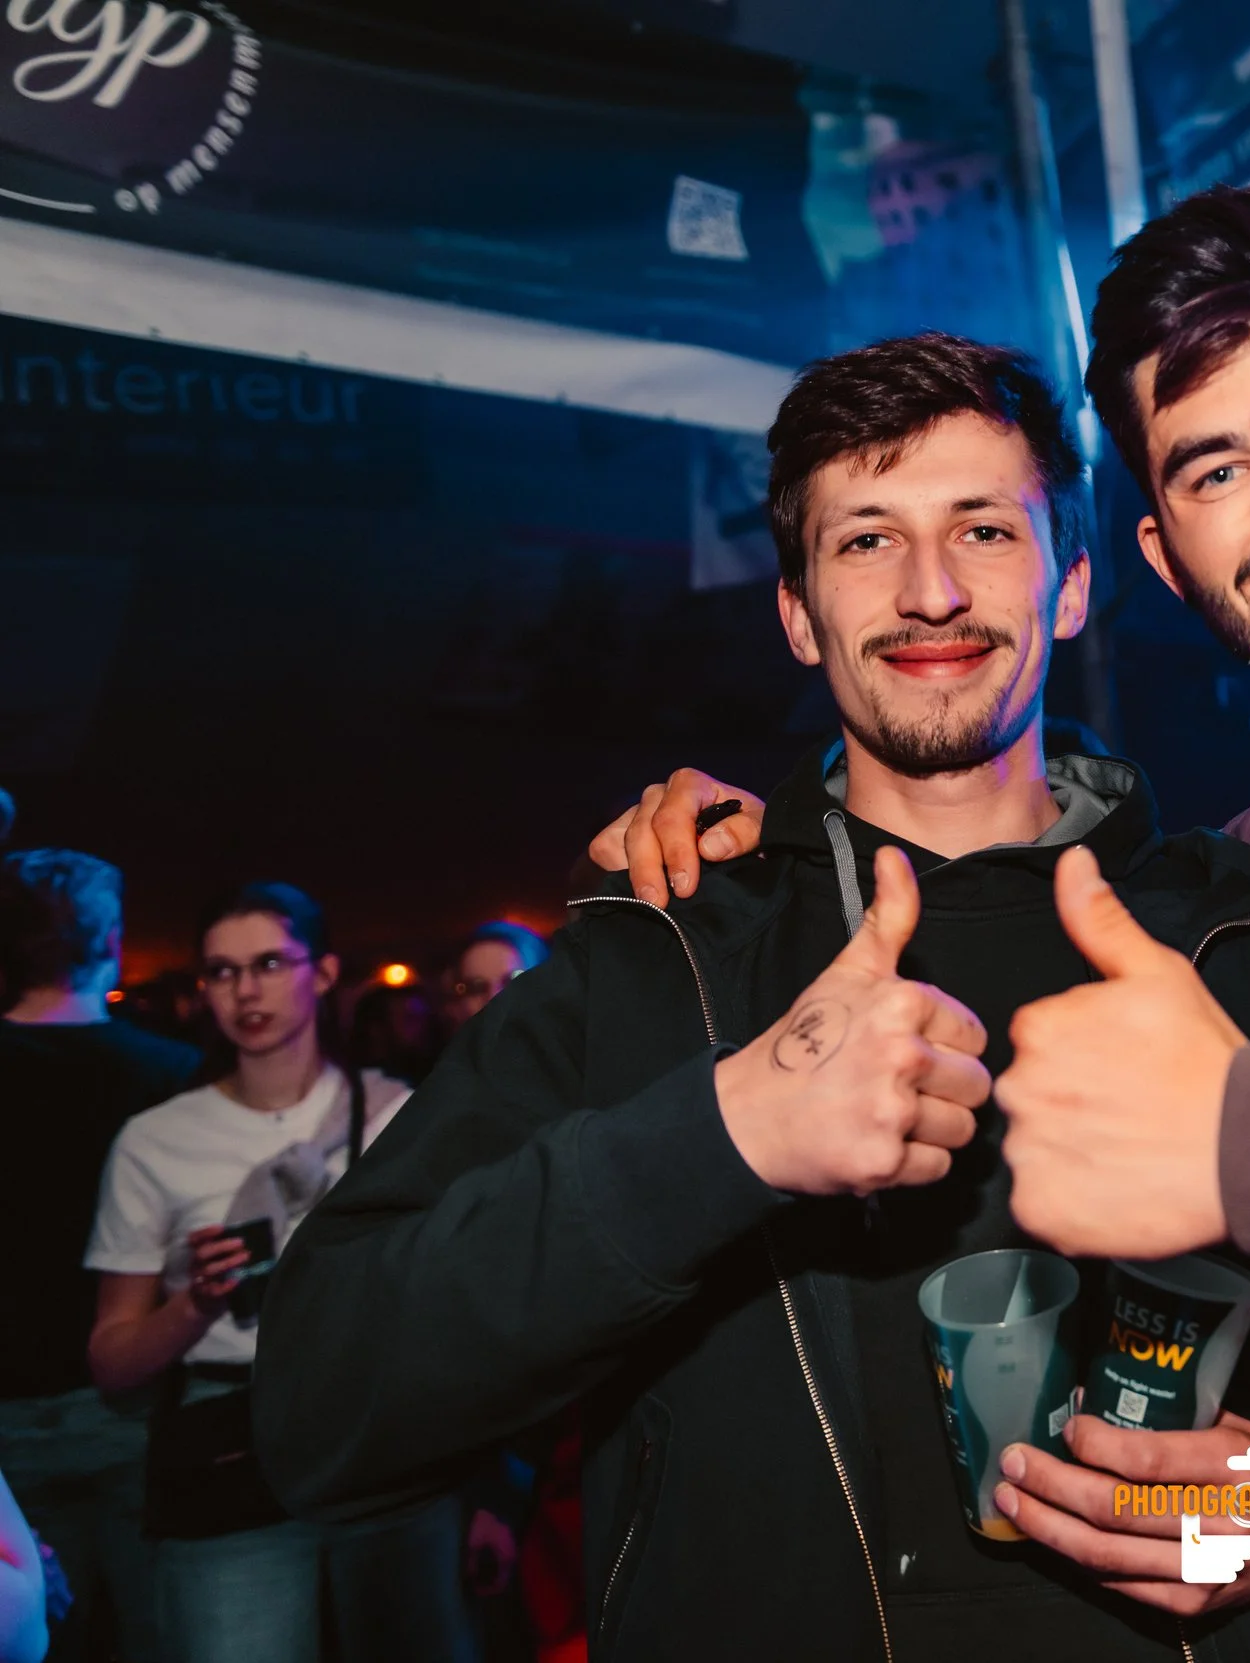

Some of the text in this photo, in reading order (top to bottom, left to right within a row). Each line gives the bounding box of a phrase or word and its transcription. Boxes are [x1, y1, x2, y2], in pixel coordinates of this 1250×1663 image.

[1114, 1295, 1200, 1343] LESS IS
[1108, 1319, 1195, 1372] NOW
